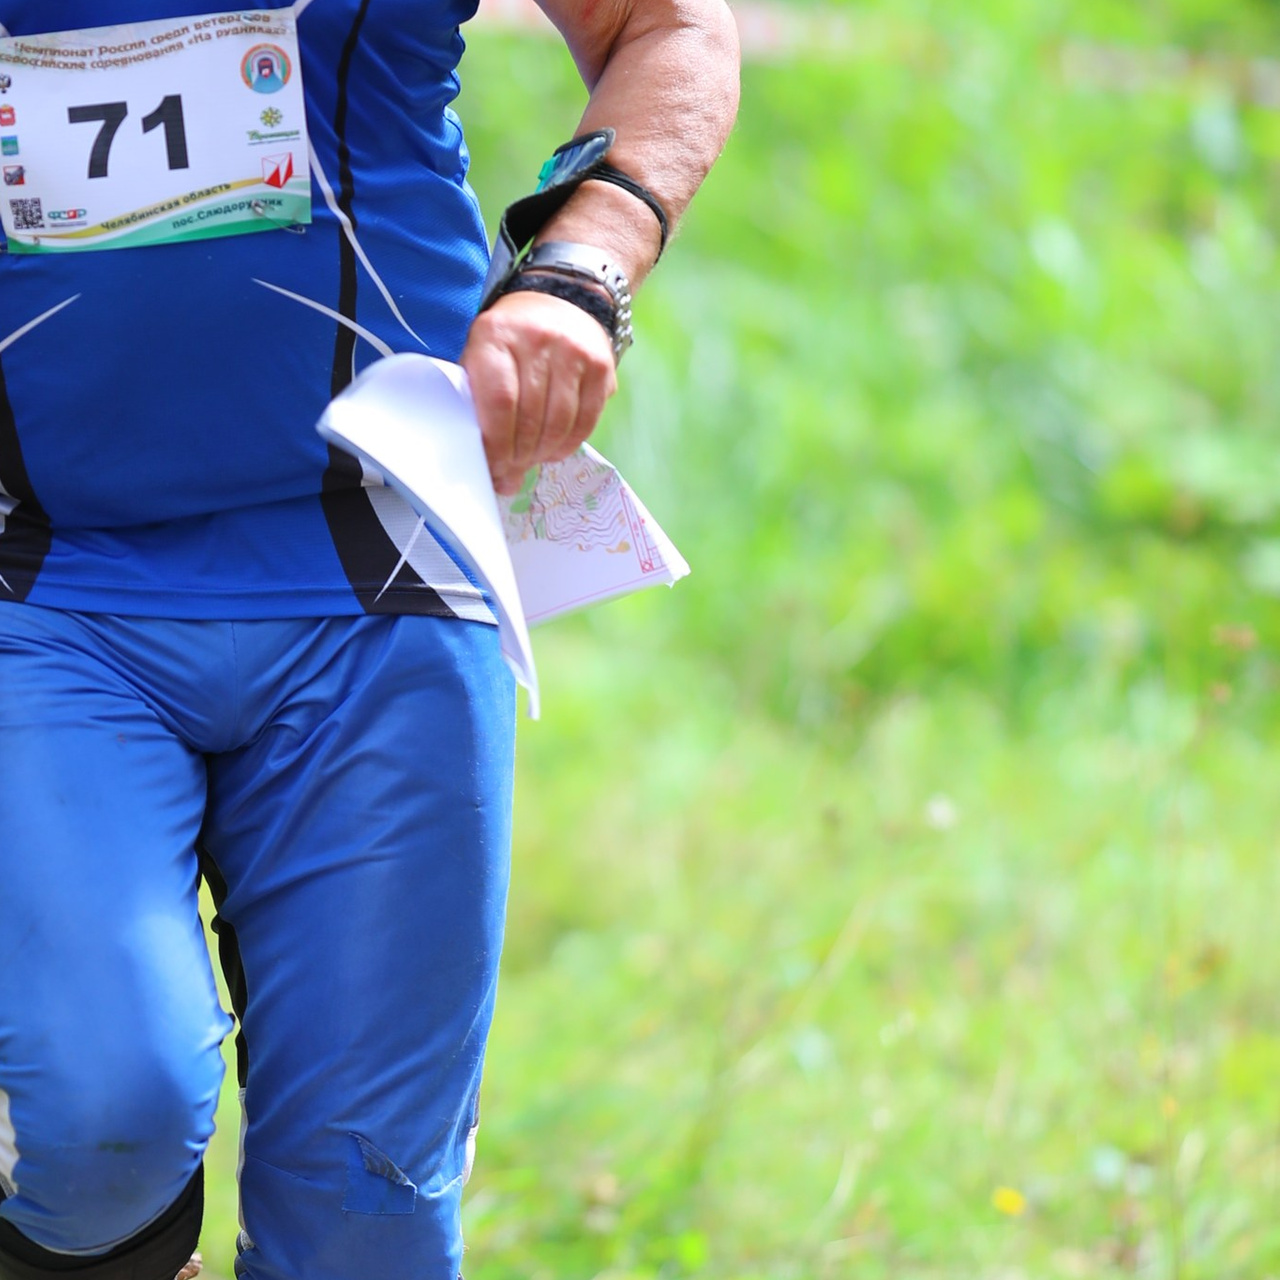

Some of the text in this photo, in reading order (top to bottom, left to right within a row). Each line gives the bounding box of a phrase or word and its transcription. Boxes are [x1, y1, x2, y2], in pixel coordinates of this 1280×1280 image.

[14, 41, 94, 58] Чемпионат
[98, 39, 146, 56] России
[150, 25, 190, 45] среди
[67, 94, 189, 179] 71
[101, 181, 231, 231] Челябинская область
